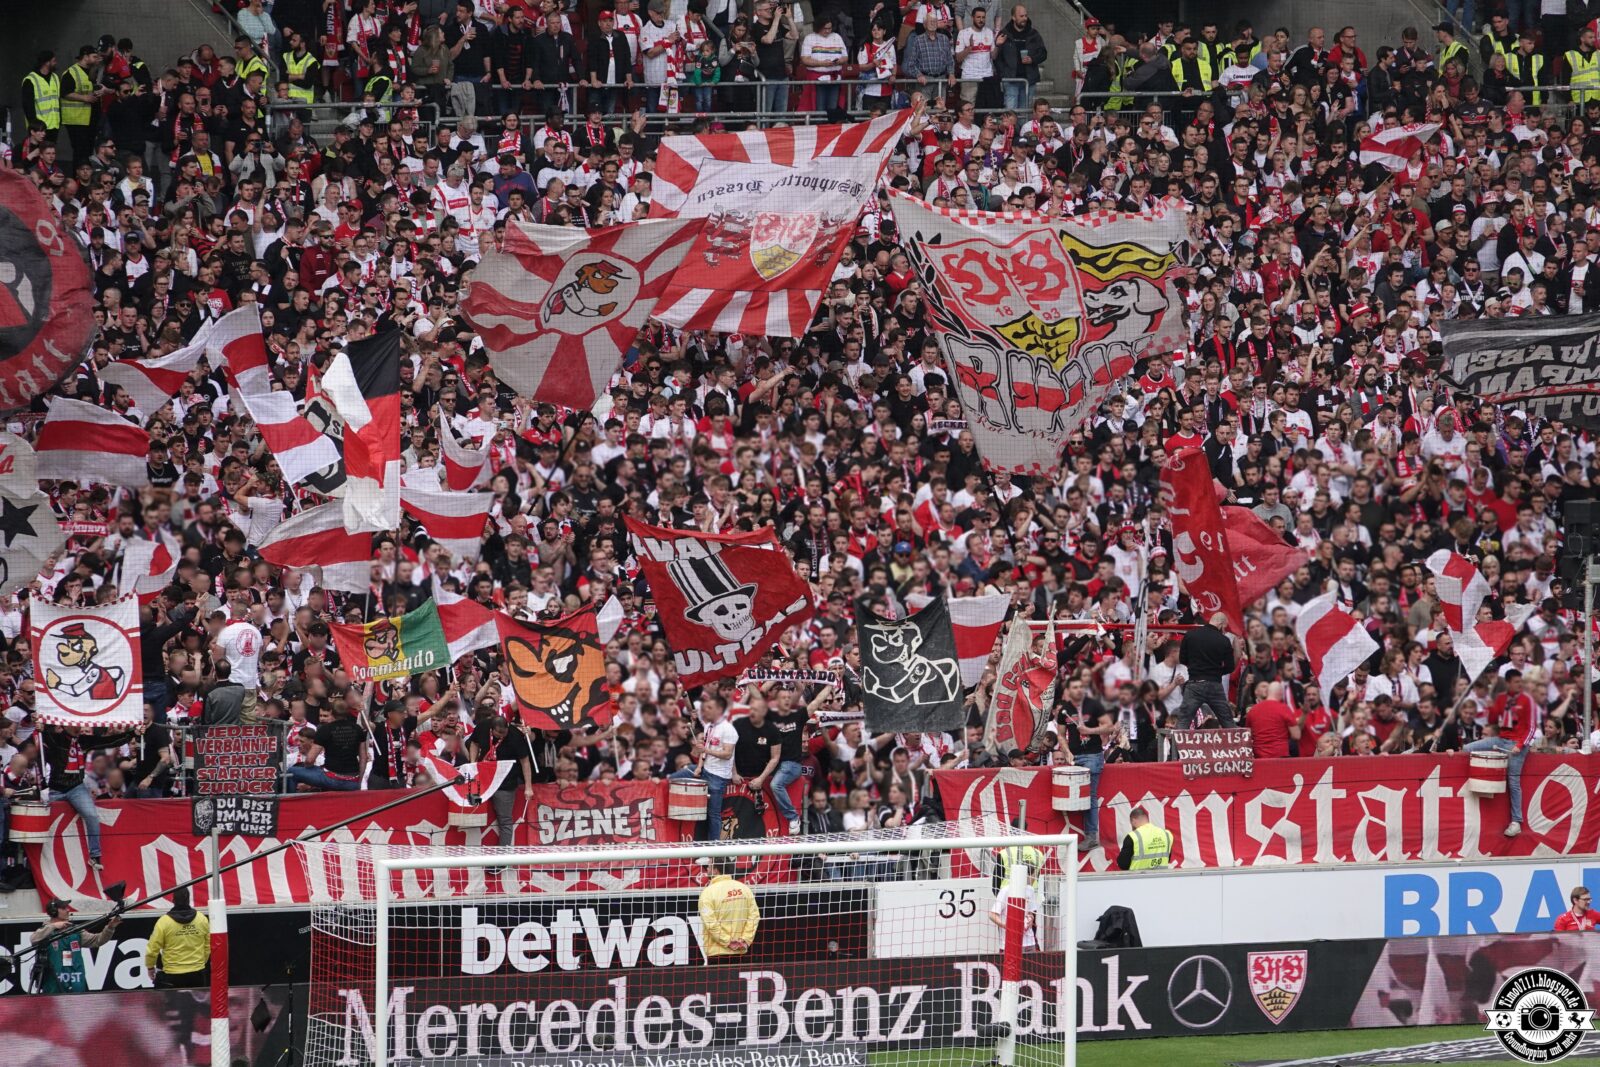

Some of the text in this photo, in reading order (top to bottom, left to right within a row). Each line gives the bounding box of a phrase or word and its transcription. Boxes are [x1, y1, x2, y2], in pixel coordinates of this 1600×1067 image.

[352, 649, 435, 680] Commando
[747, 669, 836, 681] COMMANDO
[205, 725, 268, 738] JEDER
[1174, 731, 1251, 744] ULTRA IST
[196, 736, 277, 754] VERBANNTE
[204, 753, 269, 767] KEHRT
[1178, 749, 1206, 759] DER
[197, 766, 277, 780] STÄRKER
[1183, 763, 1211, 775] UMS
[199, 780, 275, 794] ZURÜCK
[216, 798, 236, 808] DU
[1526, 762, 1600, 858] 9
[216, 810, 272, 825] IMMER
[538, 797, 656, 845] SZENE E
[241, 823, 273, 835] UNS!
[938, 889, 977, 919] 35
[335, 955, 1152, 1066] Mercedes-Benz Bank
[806, 1047, 861, 1067] Bank
